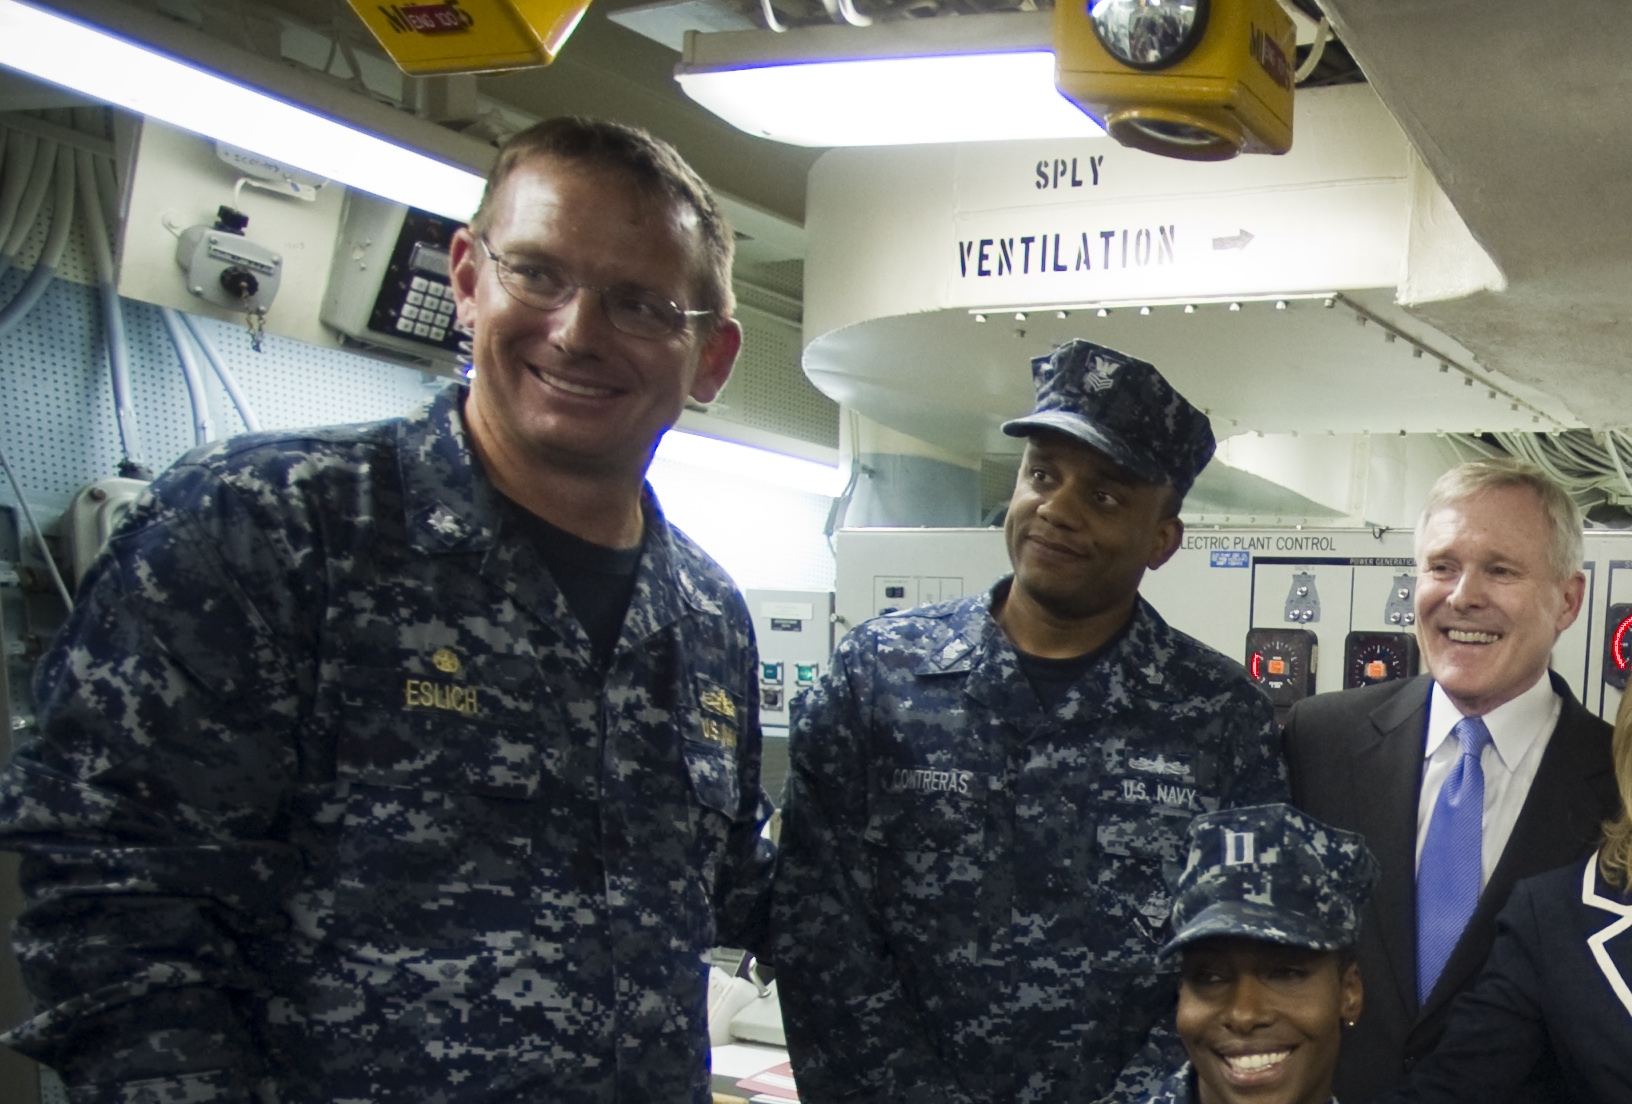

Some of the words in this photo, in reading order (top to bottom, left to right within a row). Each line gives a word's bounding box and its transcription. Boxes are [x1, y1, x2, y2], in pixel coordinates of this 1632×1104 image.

[410, 13, 435, 29] ENG
[436, 11, 460, 26] 100
[1035, 155, 1104, 190] SPLY
[958, 224, 1175, 278] VENTILATION
[1179, 536, 1230, 551] LECTRIC
[1233, 536, 1272, 551] PLANT
[1275, 536, 1337, 551] CONTROL
[1350, 558, 1373, 566] POWER
[1123, 780, 1150, 801] U.S.
[1156, 784, 1197, 808] NAVY
